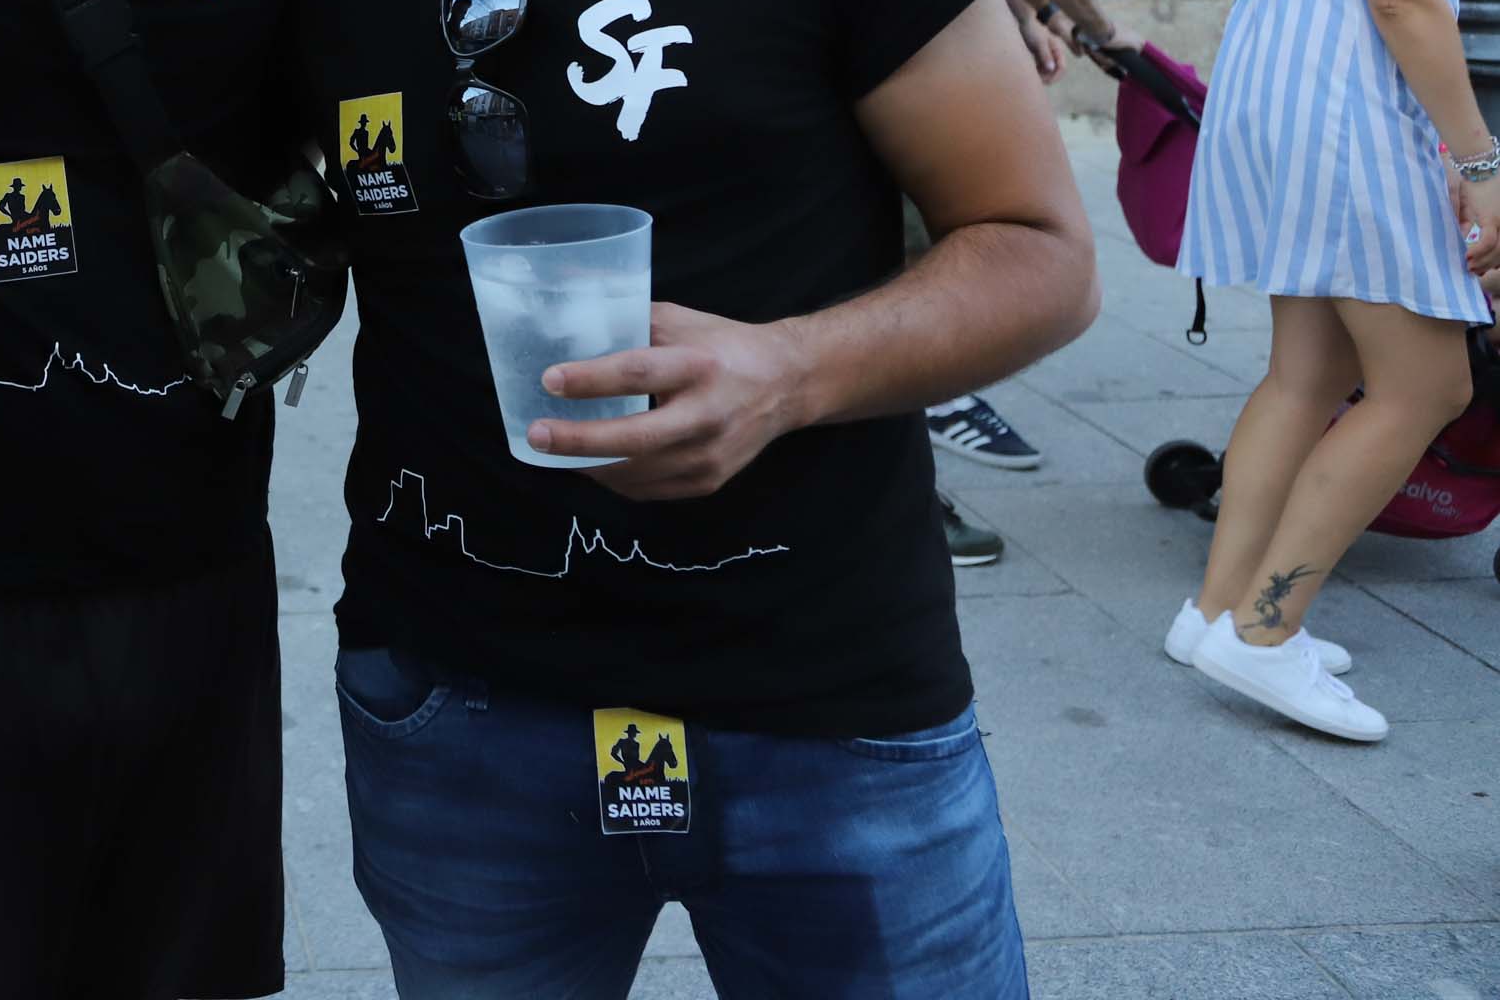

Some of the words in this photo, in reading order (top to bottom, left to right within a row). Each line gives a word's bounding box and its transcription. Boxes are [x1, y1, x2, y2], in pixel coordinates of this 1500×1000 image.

[357, 171, 395, 186] NAME
[356, 185, 408, 202] SAIDERS
[7, 233, 57, 251] NAME
[22, 266, 27, 274] 5
[28, 264, 48, 273] AÑOS
[1398, 482, 1453, 505] alvo
[618, 786, 671, 801] NAME
[608, 803, 685, 818] SAIDERS
[639, 818, 661, 827] AÑOS
